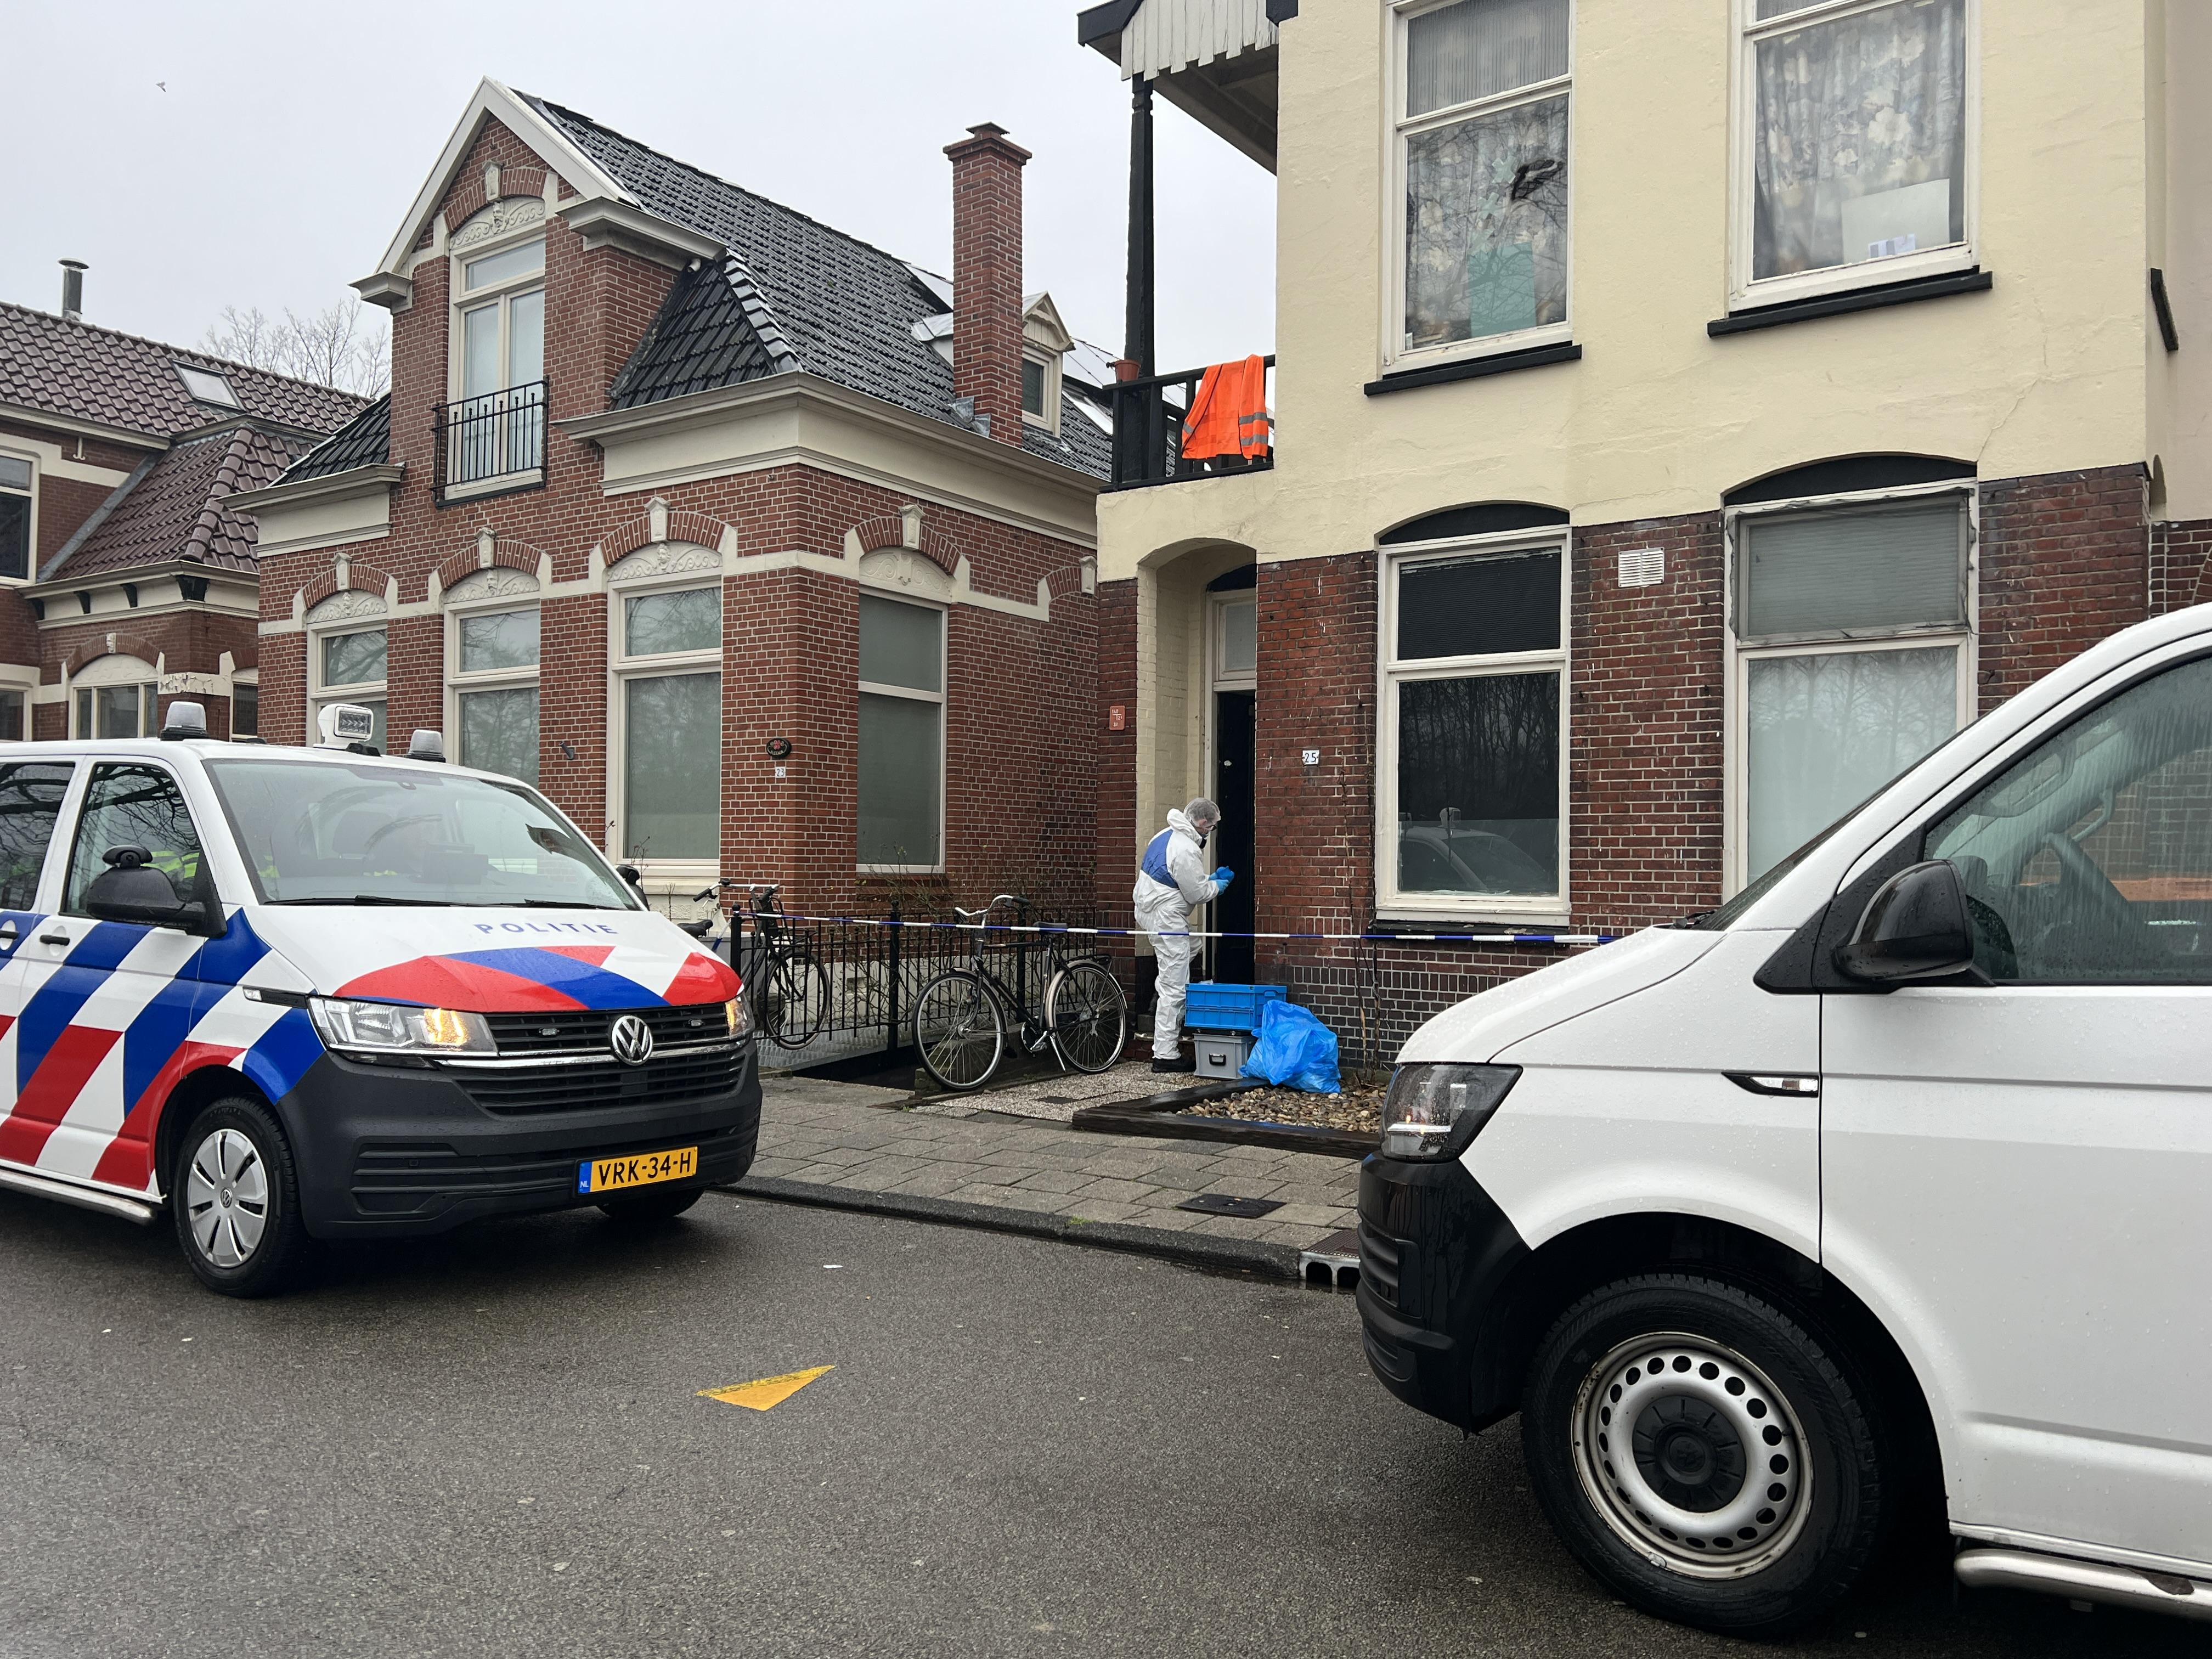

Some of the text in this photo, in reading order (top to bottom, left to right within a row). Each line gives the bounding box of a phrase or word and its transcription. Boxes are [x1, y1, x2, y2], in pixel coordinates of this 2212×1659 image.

[1305, 752, 1317, 763] 25
[777, 768, 785, 777] 23
[473, 923, 619, 934] POLITIE
[598, 1151, 691, 1186] VRK-34-H
